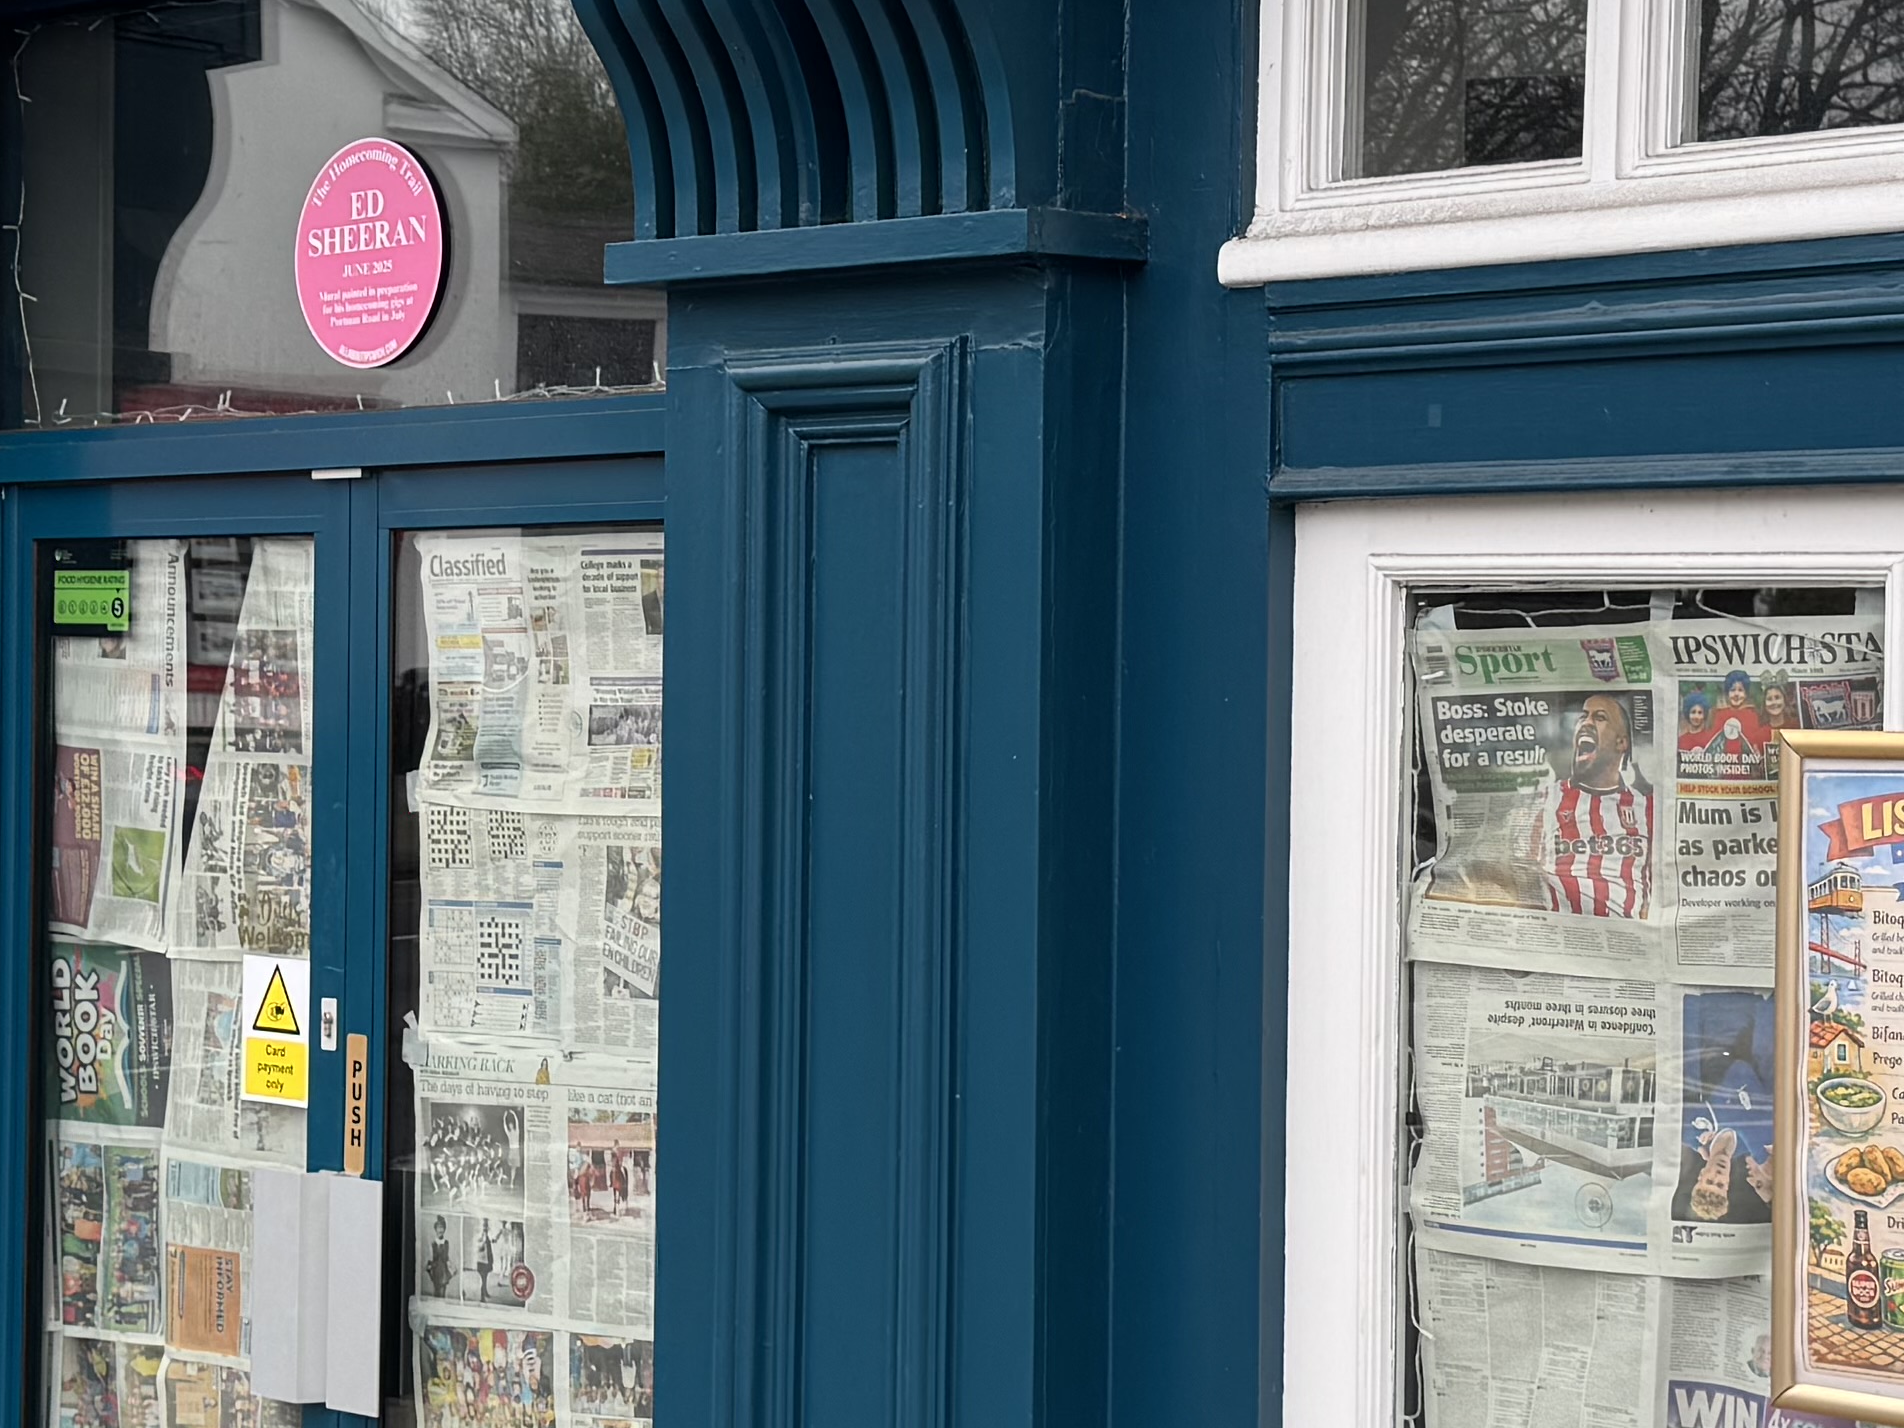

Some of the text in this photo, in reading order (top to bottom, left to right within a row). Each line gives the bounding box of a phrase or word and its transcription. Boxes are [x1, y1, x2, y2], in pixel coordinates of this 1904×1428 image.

[311, 147, 423, 208] The Homecoming Trail
[350, 189, 384, 220] ED
[308, 215, 427, 257] SHEERAN
[342, 260, 393, 278] JUNE 2025
[342, 286, 368, 301] painted
[369, 285, 376, 297] in
[377, 282, 418, 299] preparation
[322, 303, 333, 315] for
[334, 302, 344, 313] his
[345, 299, 389, 313] homecoming
[362, 312, 381, 324] Road
[382, 311, 389, 322] in
[390, 309, 405, 323] July
[430, 553, 506, 577] Classified
[580, 560, 632, 571] College marks a
[58, 576, 125, 584] FOOD HYGIENE RATING
[582, 571, 638, 584] decade of support
[582, 583, 637, 593] for local business
[113, 600, 122, 616] 5
[165, 553, 180, 687] Announcements
[1669, 631, 1884, 666] IPSWICH STA
[1455, 643, 1558, 685] Sport
[1437, 697, 1549, 720] Boss: Stoke
[1440, 725, 1536, 746] desperate
[1443, 746, 1546, 769] for a result
[1680, 752, 1761, 764] WORLD BOOK DAY
[1680, 763, 1750, 775] PHOTOS INSIDE!
[1679, 802, 1761, 825] Mum is
[1555, 834, 1645, 857] bet365
[1678, 838, 1704, 856] as
[1681, 865, 1746, 887] chaos
[1682, 898, 1776, 909] Developer working on
[1504, 1000, 1656, 1020] three closures in three months
[52, 957, 77, 1102] WORLD
[74, 970, 99, 1094] BOOK
[96, 1005, 115, 1060] Day
[148, 993, 160, 1080] IPSWICH STAR
[266, 1044, 286, 1057] Card
[1873, 1052, 1903, 1069] Prego
[257, 1061, 293, 1076] payment
[266, 1079, 284, 1093] only
[351, 1060, 362, 1147] PUSH
[225, 1258, 233, 1293] STAY
[215, 1256, 224, 1333] INFORMED
